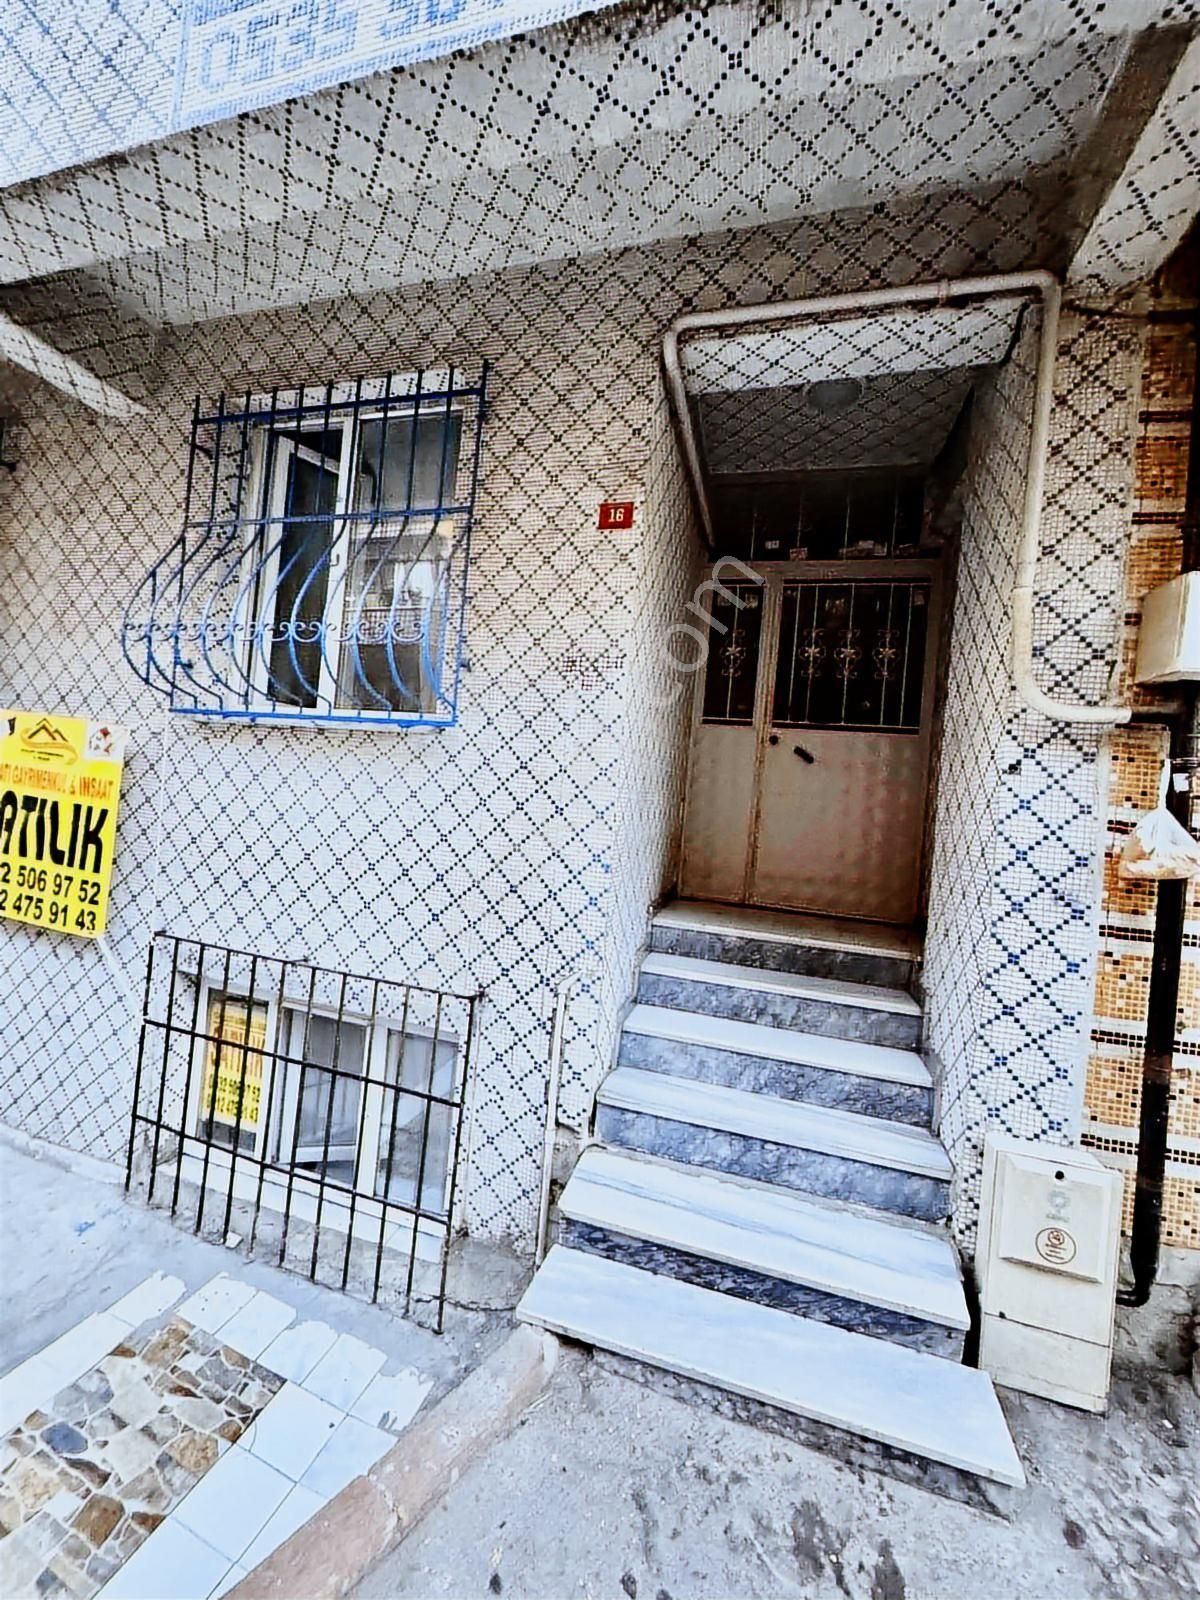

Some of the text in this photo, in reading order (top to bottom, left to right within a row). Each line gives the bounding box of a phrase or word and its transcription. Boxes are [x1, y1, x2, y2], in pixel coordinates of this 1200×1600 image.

[608, 508, 625, 522] 16
[16, 865, 48, 892] 506
[52, 873, 74, 898] 97
[78, 879, 101, 905] 52
[12, 893, 44, 920] 475
[48, 901, 69, 927] 91
[75, 908, 97, 931] 43
